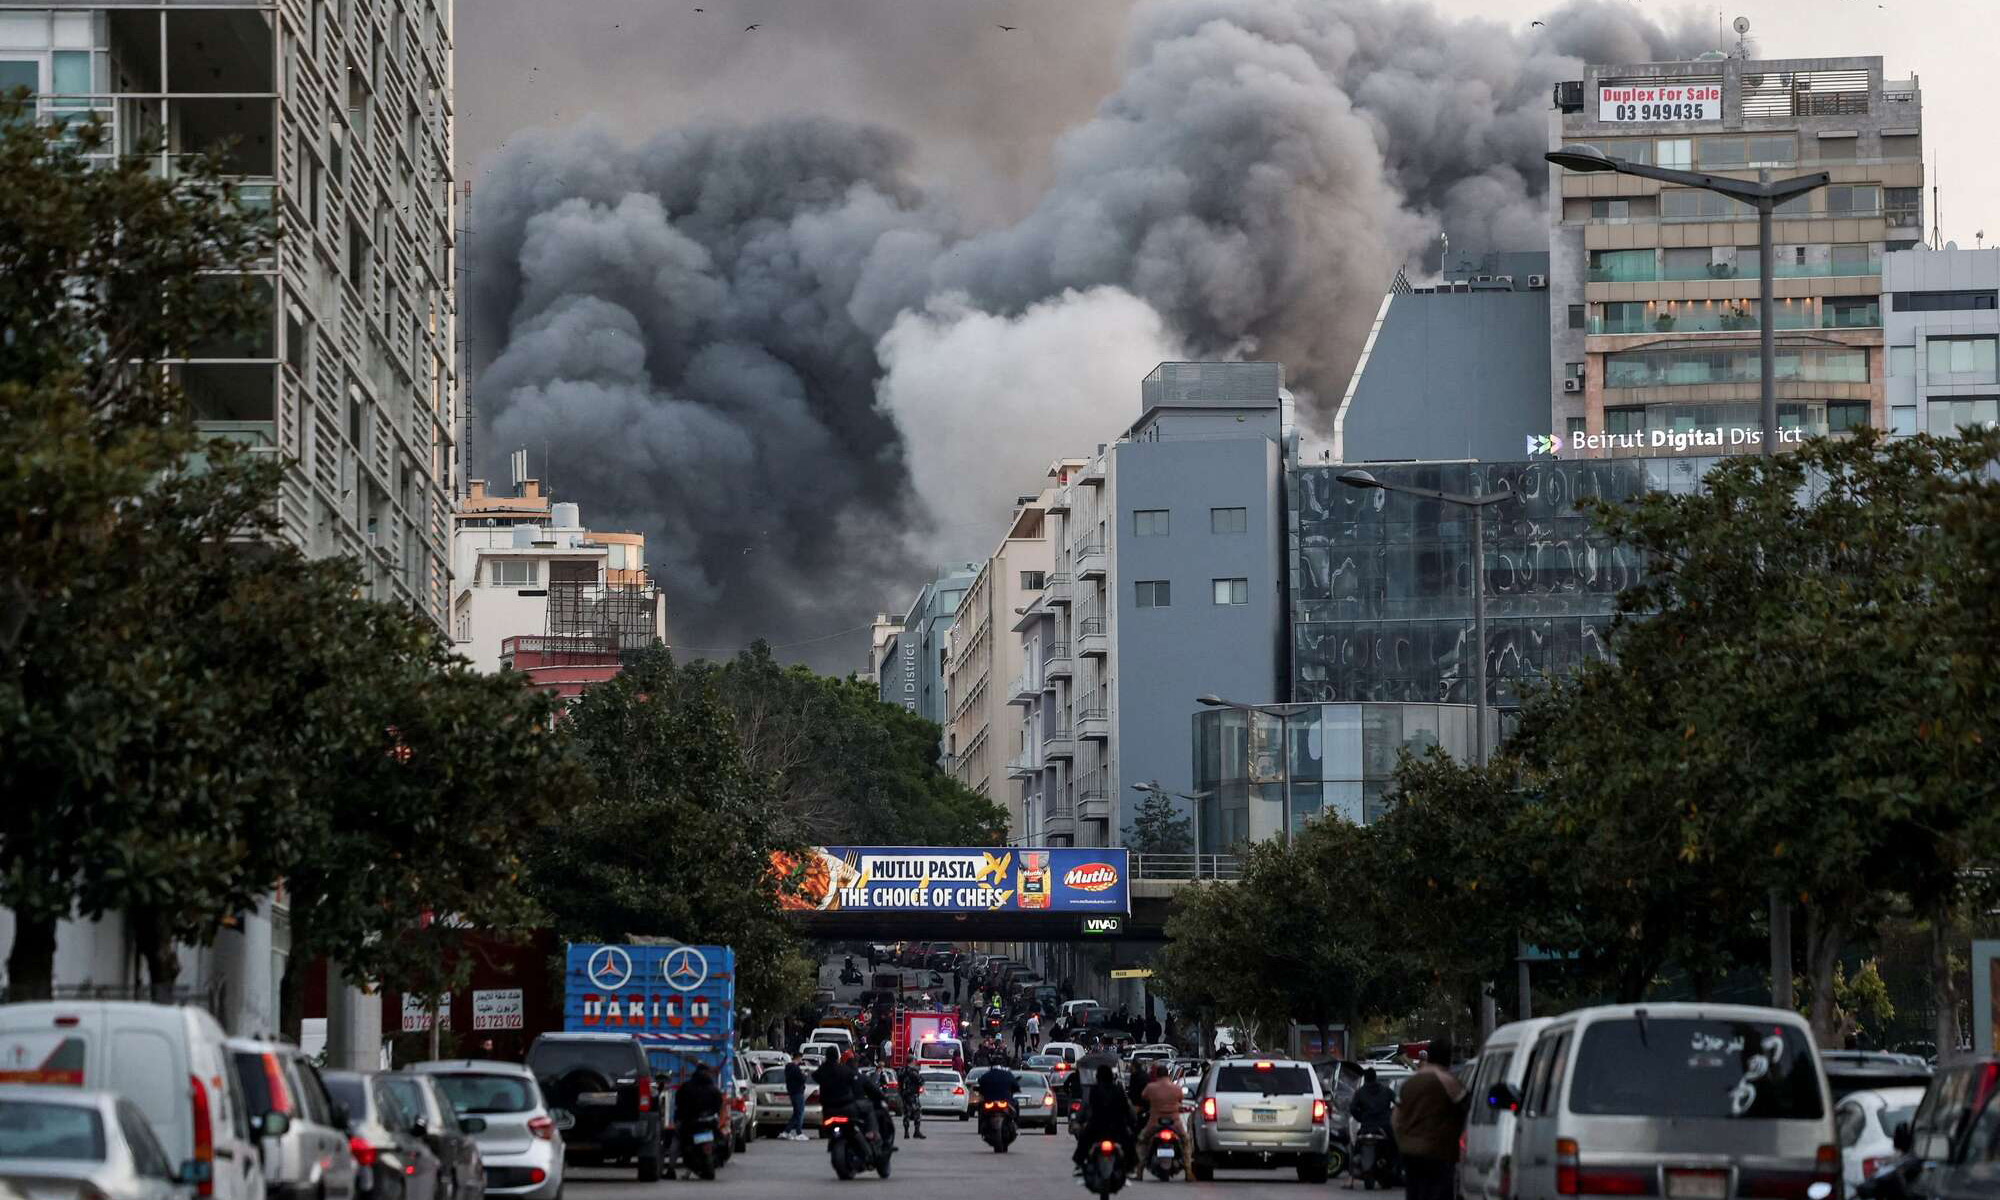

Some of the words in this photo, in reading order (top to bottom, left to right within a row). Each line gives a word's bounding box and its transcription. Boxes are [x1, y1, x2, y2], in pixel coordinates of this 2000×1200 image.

[1603, 89, 1653, 103] Duplex
[1659, 88, 1682, 100] For
[1687, 86, 1719, 100] Sale
[1617, 104, 1636, 121] 03
[1641, 103, 1703, 120] 949435
[1574, 430, 1644, 449] Beirut
[1652, 428, 1722, 451] Digital
[1731, 426, 1802, 444] Disict
[904, 643, 914, 692] District
[872, 861, 923, 878] MUTLU
[928, 861, 976, 878] PASTA
[1064, 868, 1114, 885] Mutlu
[840, 888, 868, 906] THE
[873, 888, 928, 906] CHOICE
[933, 888, 952, 906] OF
[957, 888, 1005, 907] CHEFS
[475, 1015, 487, 1028] 03
[488, 1014, 504, 1027] 723
